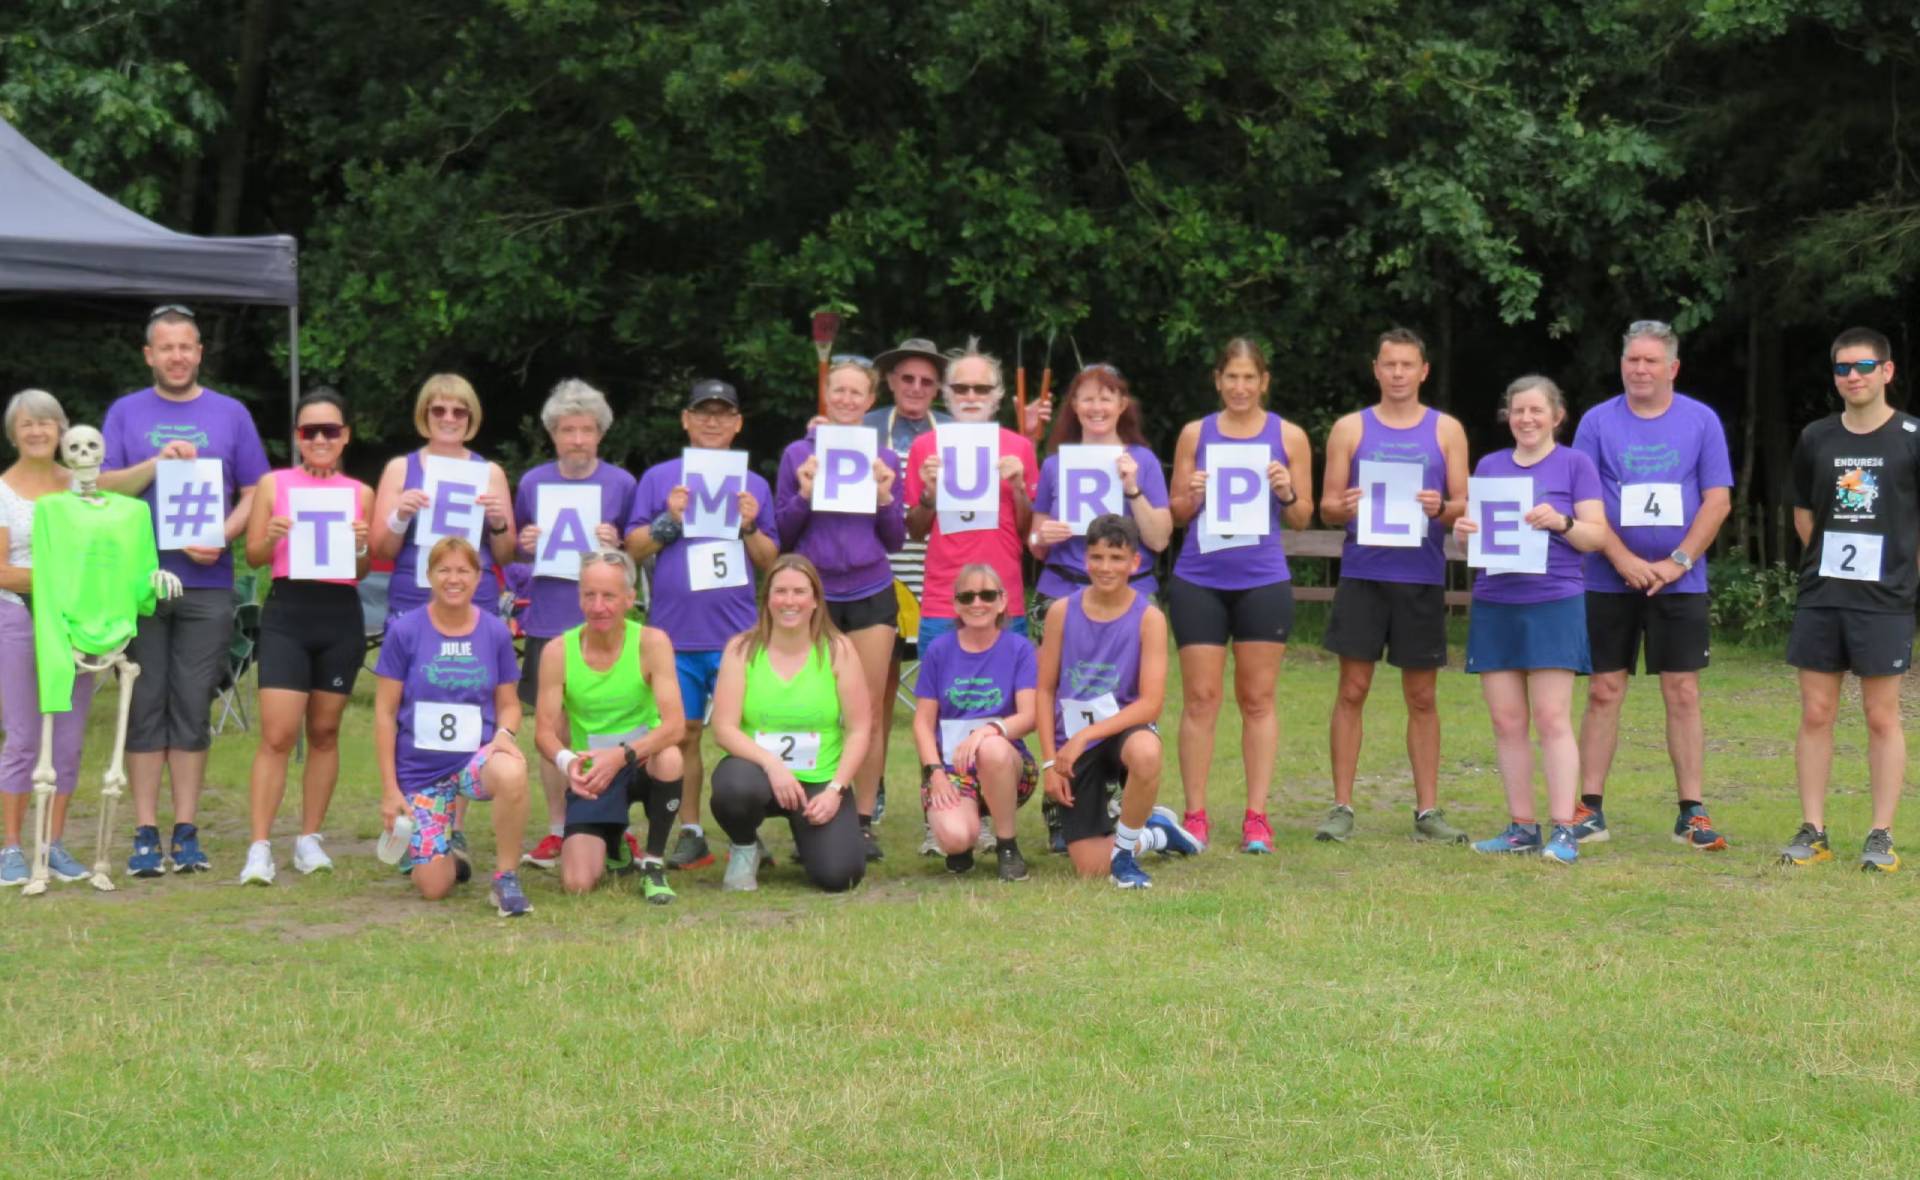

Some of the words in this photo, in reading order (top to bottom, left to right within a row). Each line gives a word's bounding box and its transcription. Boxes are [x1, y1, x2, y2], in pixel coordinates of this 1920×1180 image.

[824, 448, 870, 500] P
[943, 446, 991, 500] U
[1066, 468, 1111, 523] R
[1217, 467, 1262, 523] P
[165, 481, 219, 537] #
[431, 480, 477, 538] E
[684, 472, 742, 528] M
[1371, 482, 1410, 535] L
[1643, 492, 1661, 517] 4
[297, 510, 346, 567] T
[542, 508, 594, 561] A
[1480, 500, 1521, 556] E
[713, 552, 728, 579] 5
[1840, 544, 1857, 572] 2
[440, 641, 473, 656] JULIE
[439, 713, 457, 742] 8
[780, 735, 797, 761] 2
